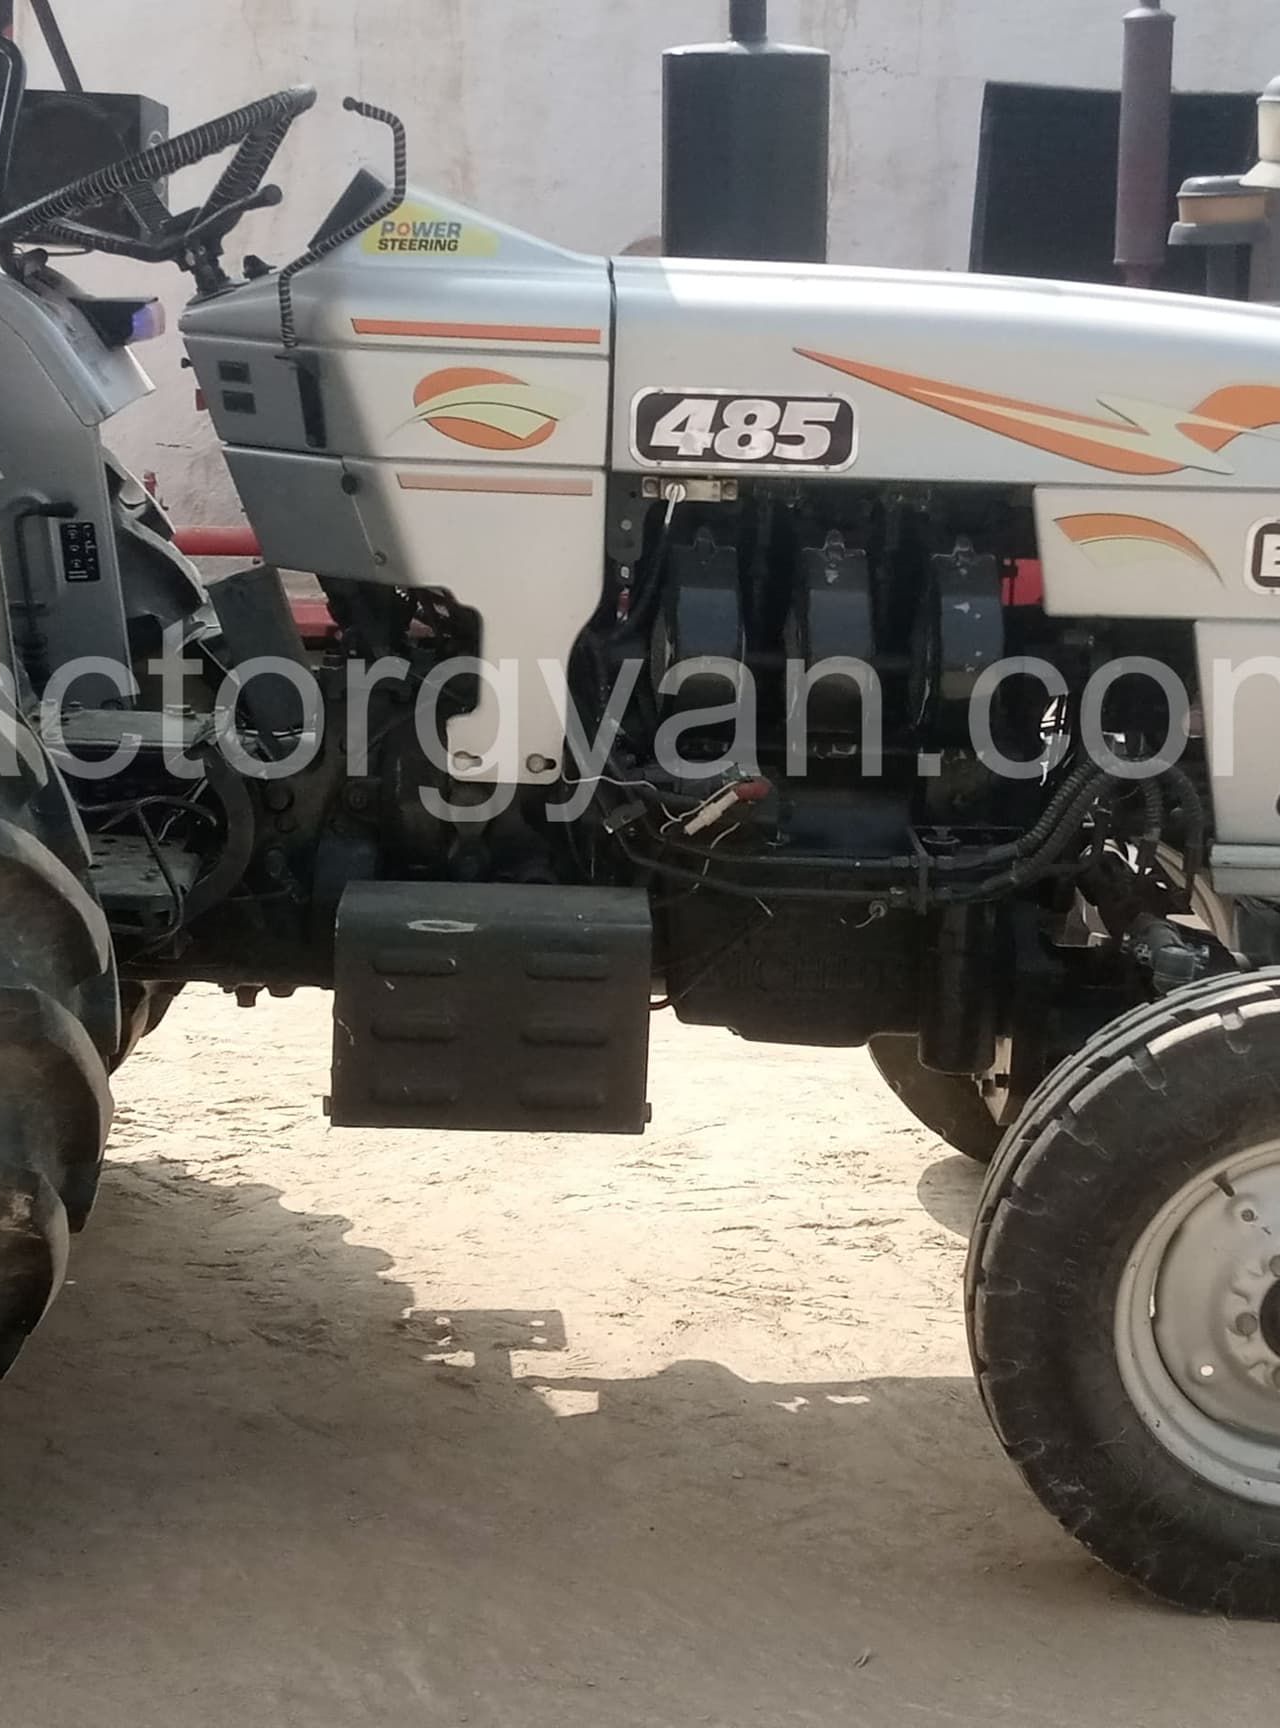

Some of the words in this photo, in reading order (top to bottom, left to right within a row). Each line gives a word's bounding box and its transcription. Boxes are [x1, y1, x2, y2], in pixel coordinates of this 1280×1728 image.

[381, 221, 462, 238] POWER
[377, 238, 458, 251] STEERING
[650, 398, 841, 460] 485
